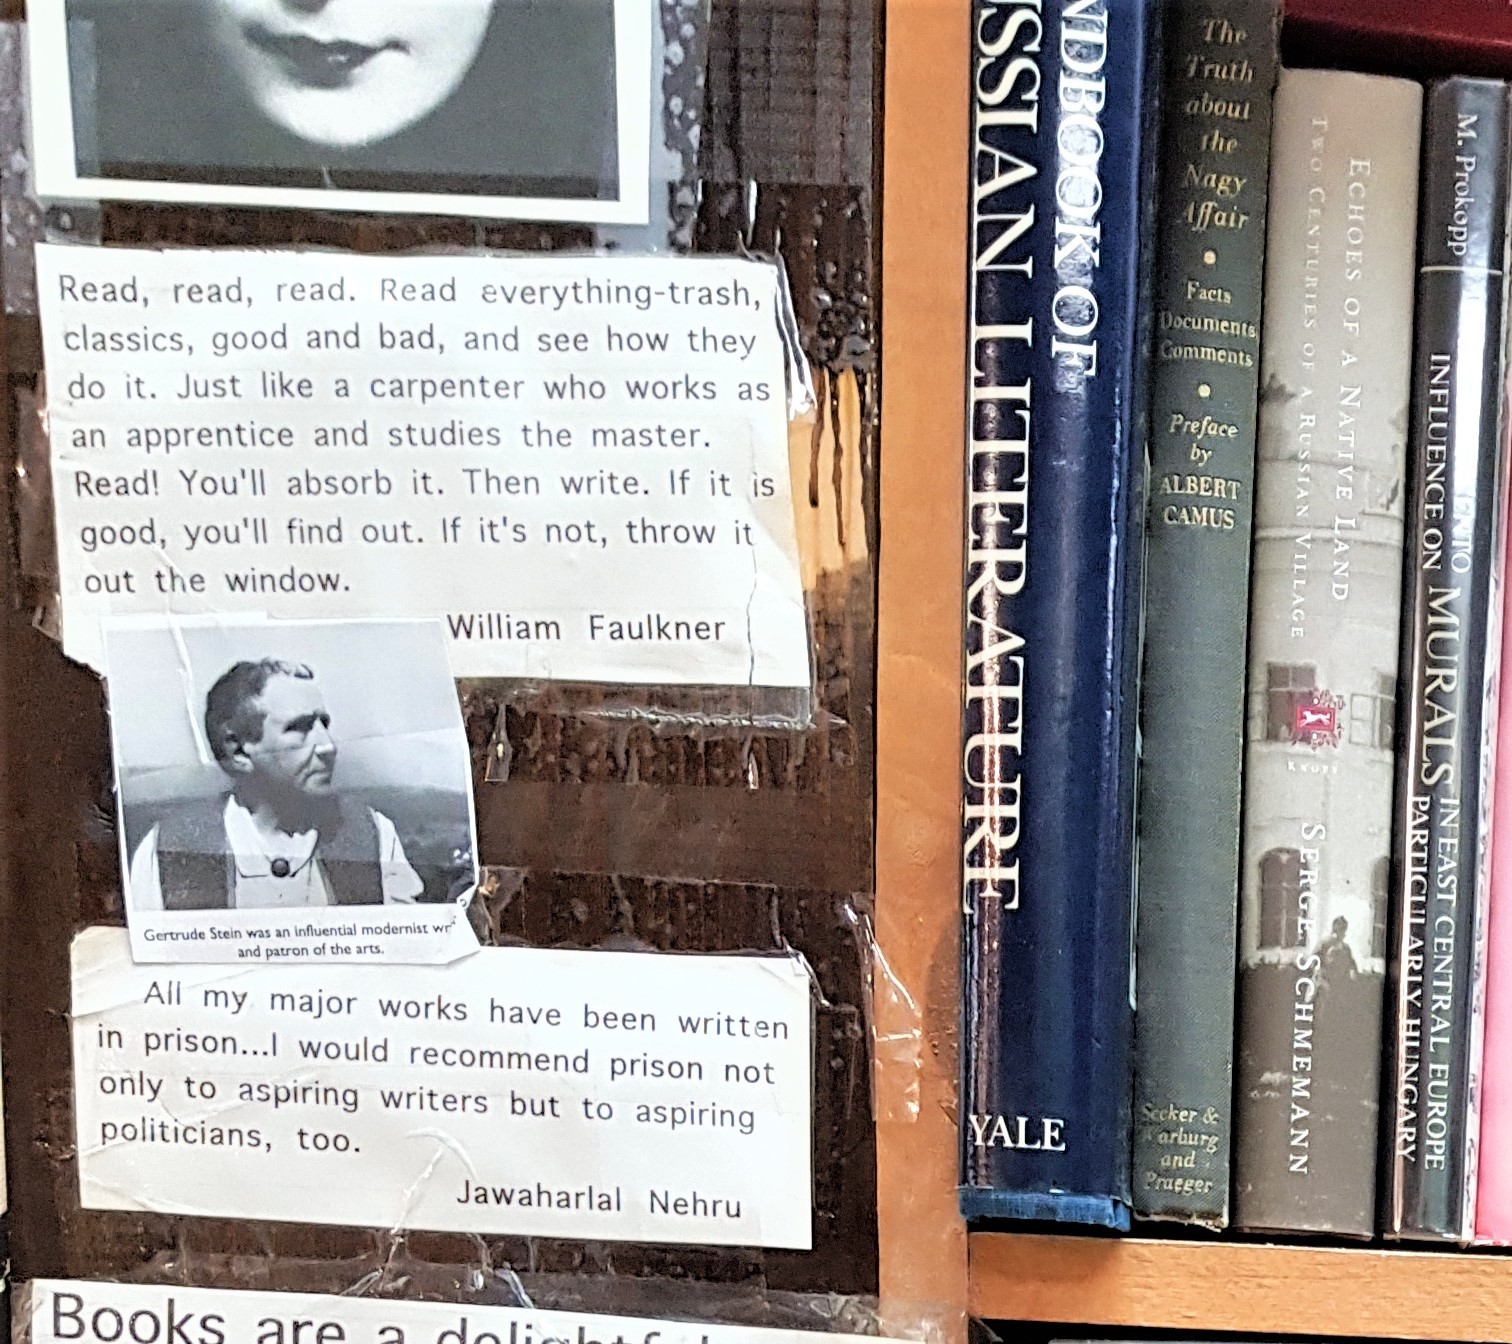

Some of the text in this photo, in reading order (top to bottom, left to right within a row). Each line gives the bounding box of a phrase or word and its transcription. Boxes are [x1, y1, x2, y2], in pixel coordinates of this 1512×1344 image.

[58, 275, 763, 312] Read, read, read. Read everything-trash,
[1163, 505, 1236, 529] CAMUS
[447, 614, 727, 642] William Faulkner
[962, 316, 1033, 913] LITERATURE
[238, 944, 384, 960] and patron of the arts.
[144, 981, 789, 1039] All my major works have been written
[967, 1116, 1066, 1152] YALE
[456, 1181, 742, 1220] Jawaharlal Nehru
